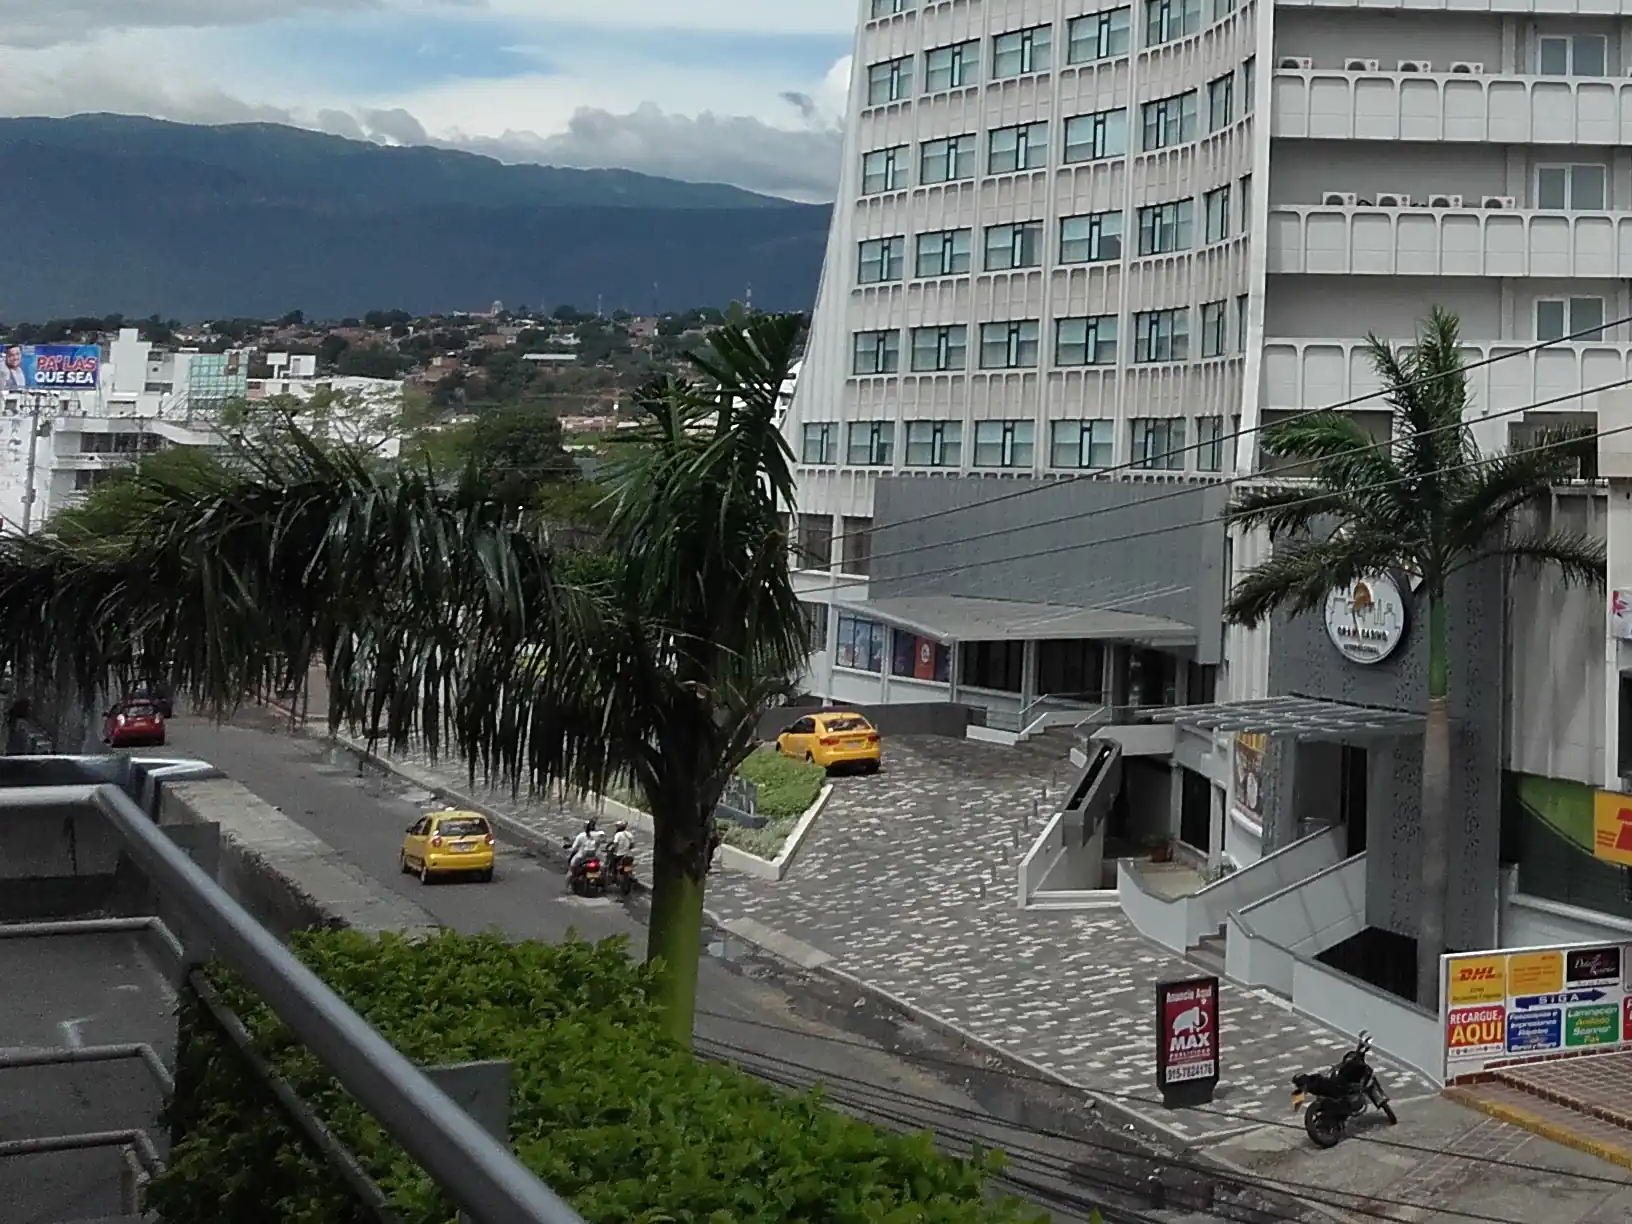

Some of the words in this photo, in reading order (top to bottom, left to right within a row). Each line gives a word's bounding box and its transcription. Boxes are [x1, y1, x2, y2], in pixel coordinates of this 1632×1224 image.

[35, 372, 65, 384] QUE
[66, 371, 95, 384] SEA
[1459, 967, 1497, 981] DHL
[1538, 993, 1580, 1005] SIGA
[1451, 1021, 1503, 1045] AQUI
[1169, 1032, 1210, 1052] MAX
